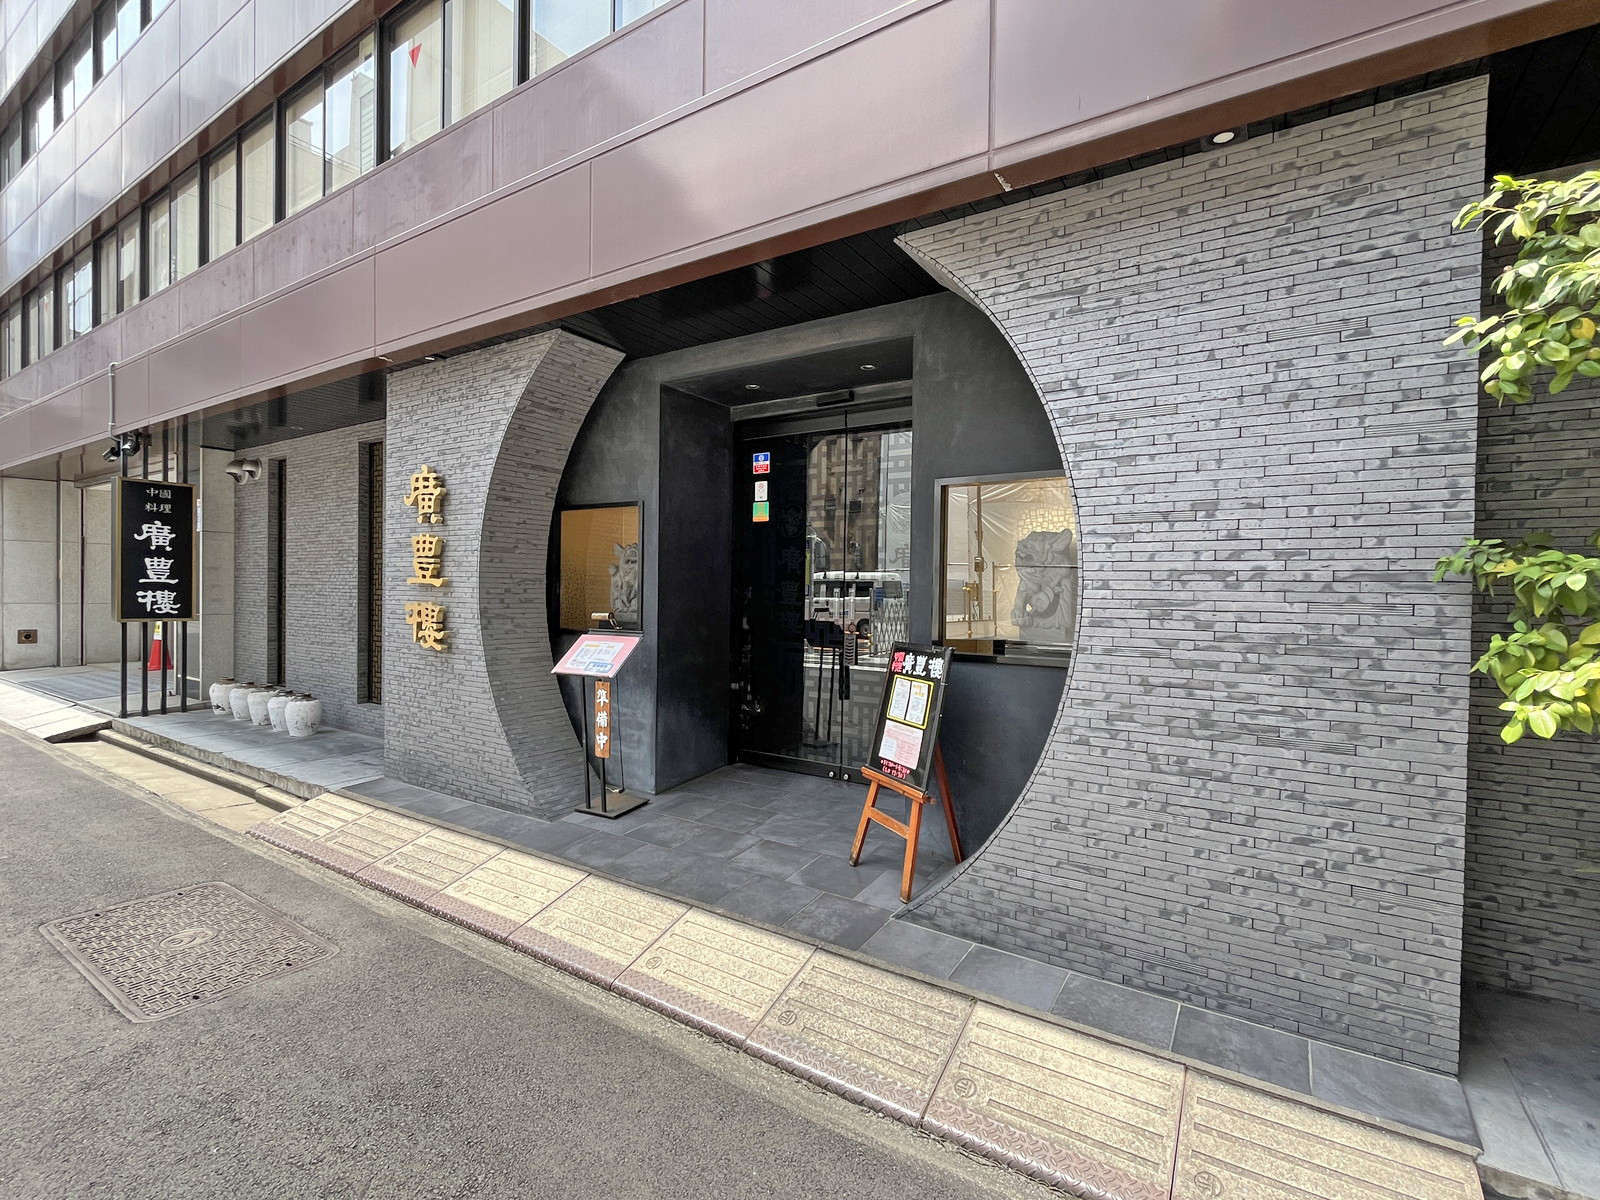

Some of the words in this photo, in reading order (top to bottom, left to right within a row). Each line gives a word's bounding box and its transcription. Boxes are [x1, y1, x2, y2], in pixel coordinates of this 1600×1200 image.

[145, 487, 172, 499] 中國
[144, 502, 173, 514] 料理
[595, 688, 610, 751] 準備中
